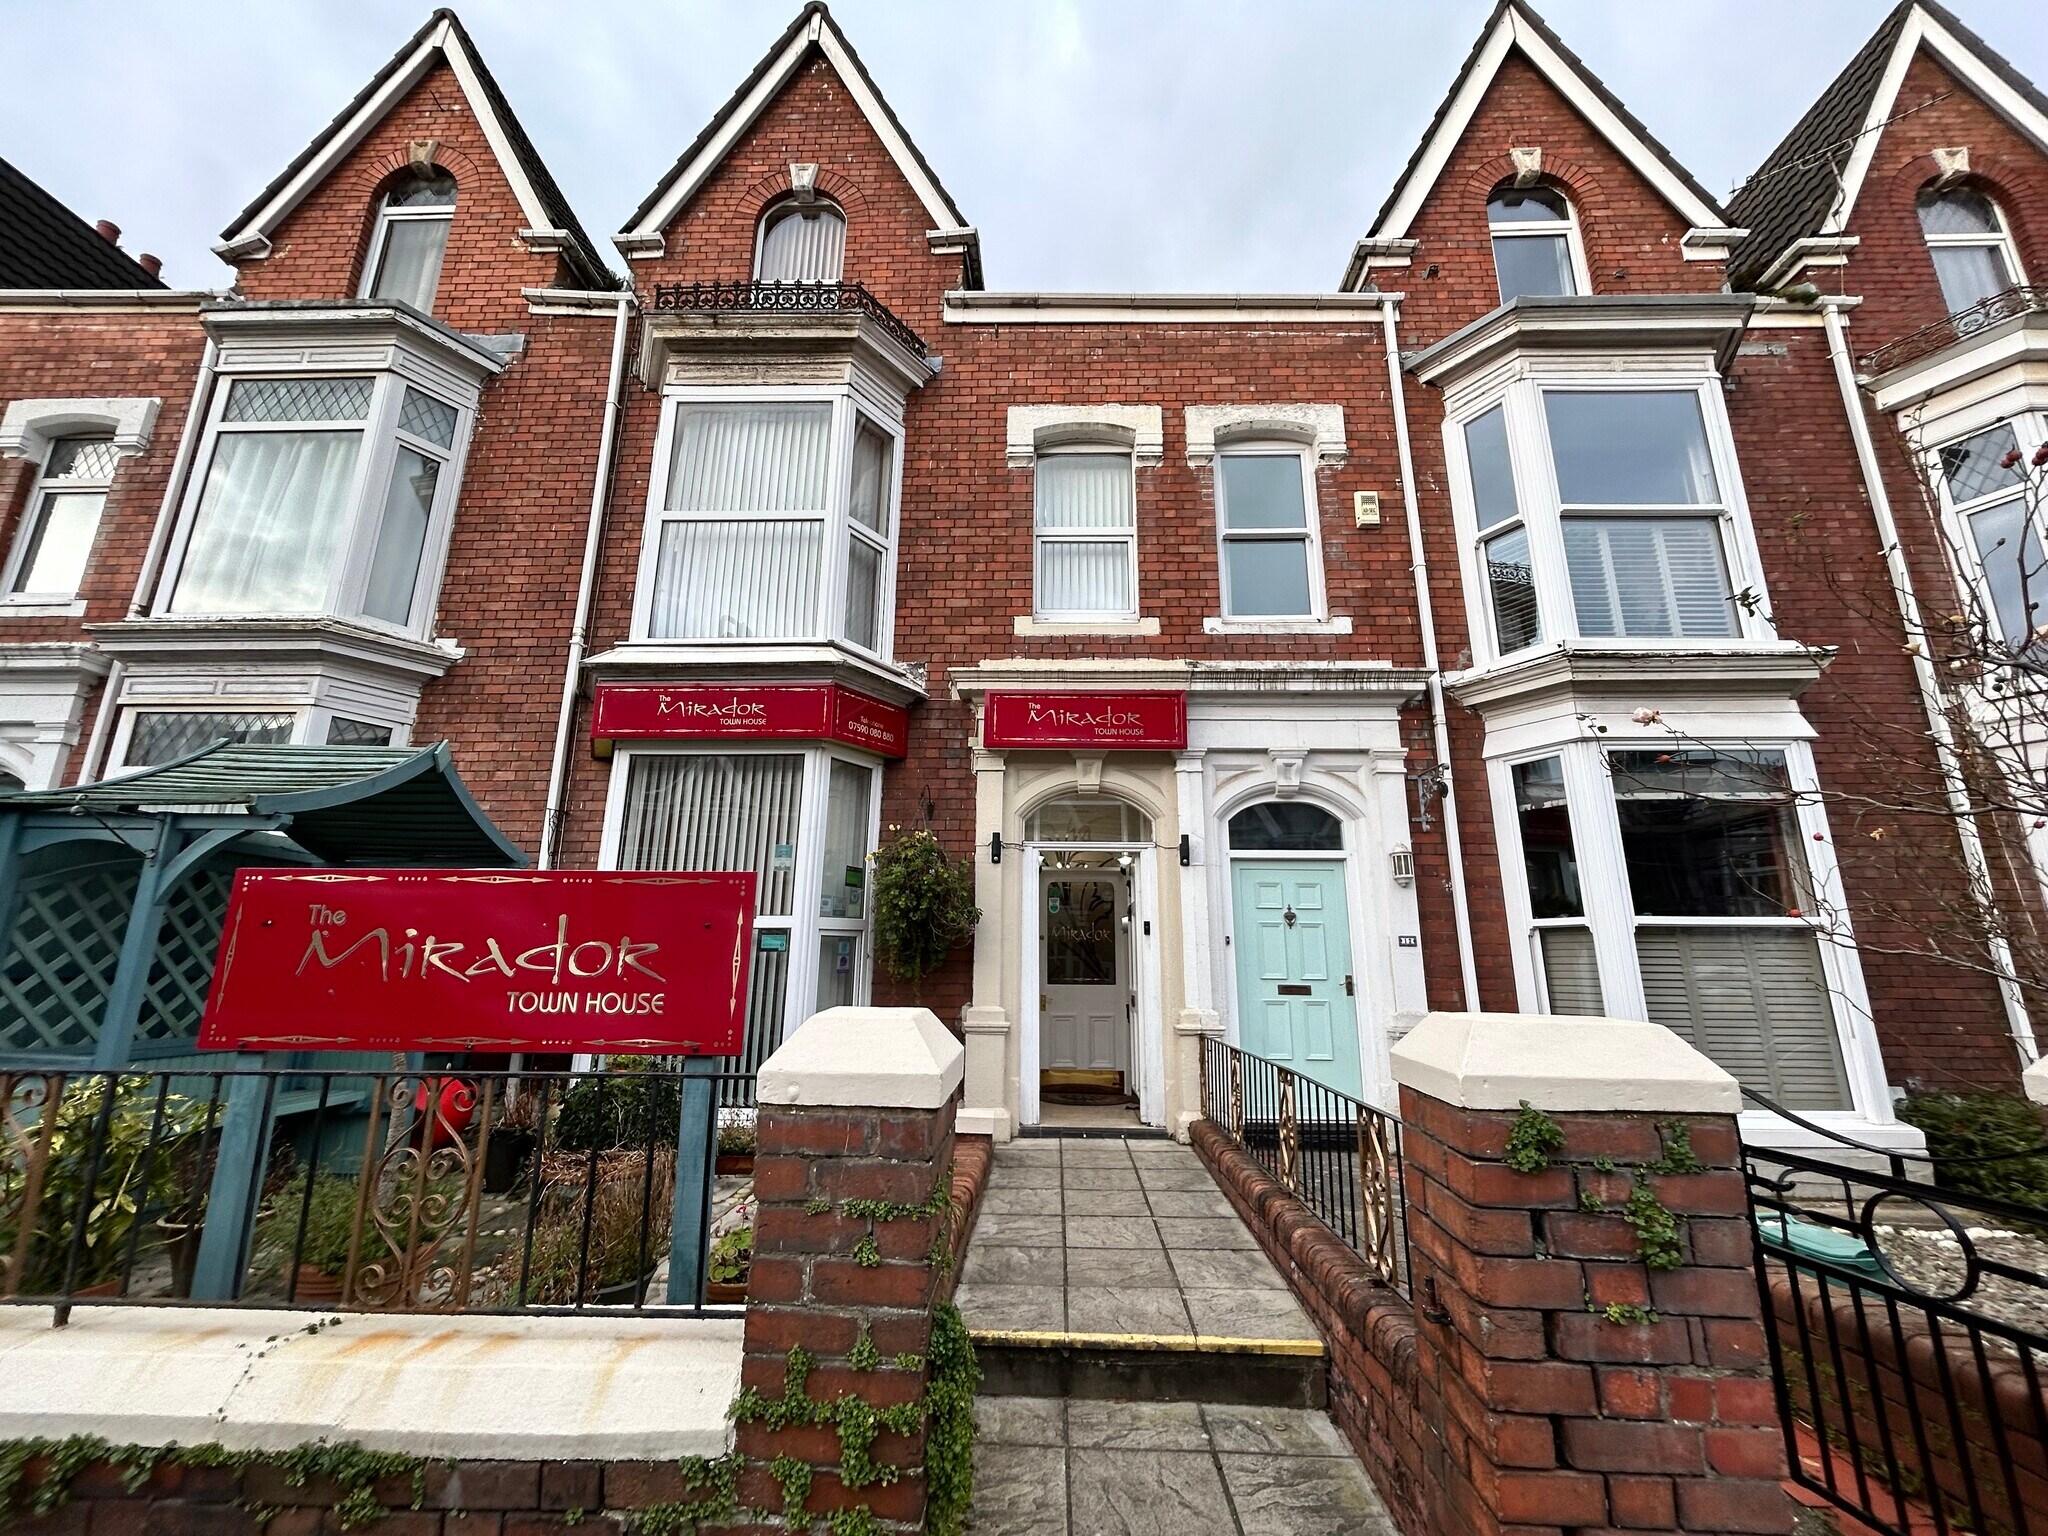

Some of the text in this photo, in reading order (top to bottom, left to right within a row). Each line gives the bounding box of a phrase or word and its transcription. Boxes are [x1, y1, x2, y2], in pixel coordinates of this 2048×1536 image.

[658, 694, 672, 702] The
[1028, 702, 1041, 710] The
[719, 718, 767, 726] TOWN HOUSE
[848, 720, 869, 735] 07590
[1094, 727, 1144, 736] TOWN HOUSE
[309, 904, 347, 926] The
[507, 991, 665, 1015] TOWN HOUSE
